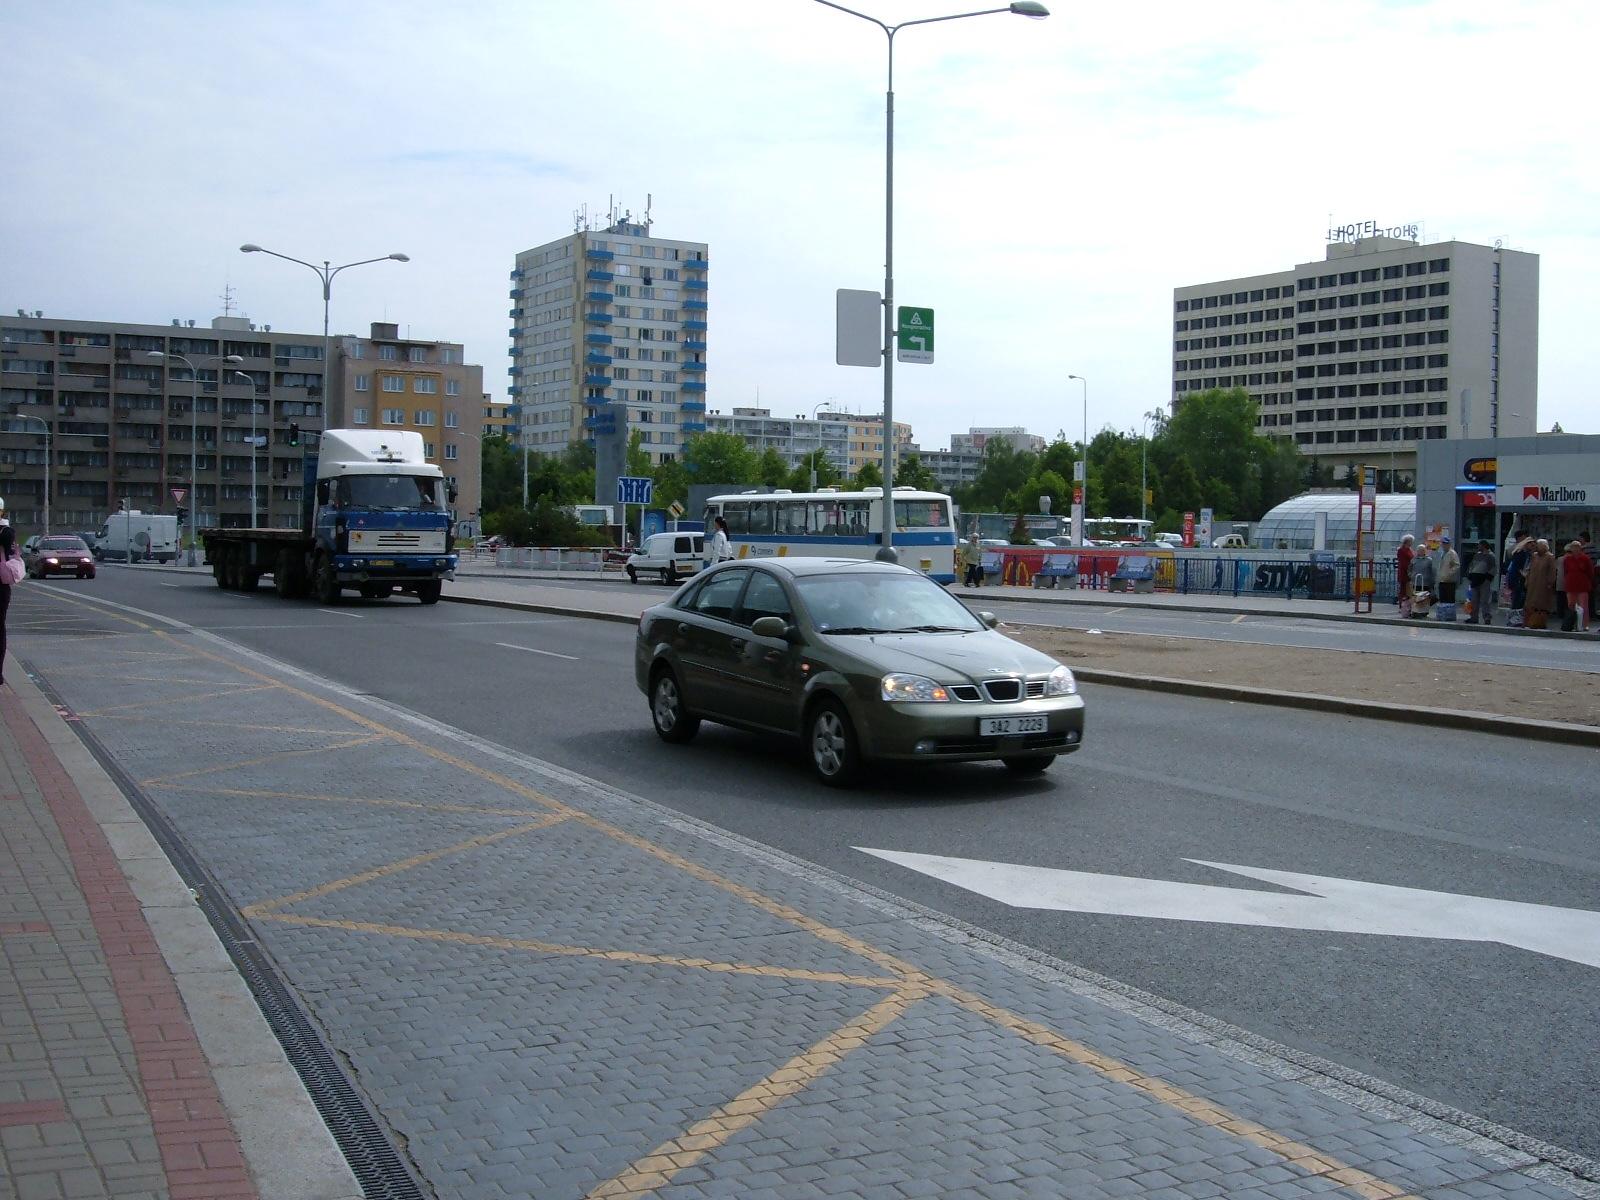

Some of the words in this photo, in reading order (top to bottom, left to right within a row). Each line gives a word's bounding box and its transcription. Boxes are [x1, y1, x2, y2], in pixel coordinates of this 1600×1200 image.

[1337, 221, 1380, 238] HOTEL
[1540, 486, 1586, 502] Marlboro
[989, 720, 1010, 733] 3A2
[1018, 718, 1043, 731] 2229
